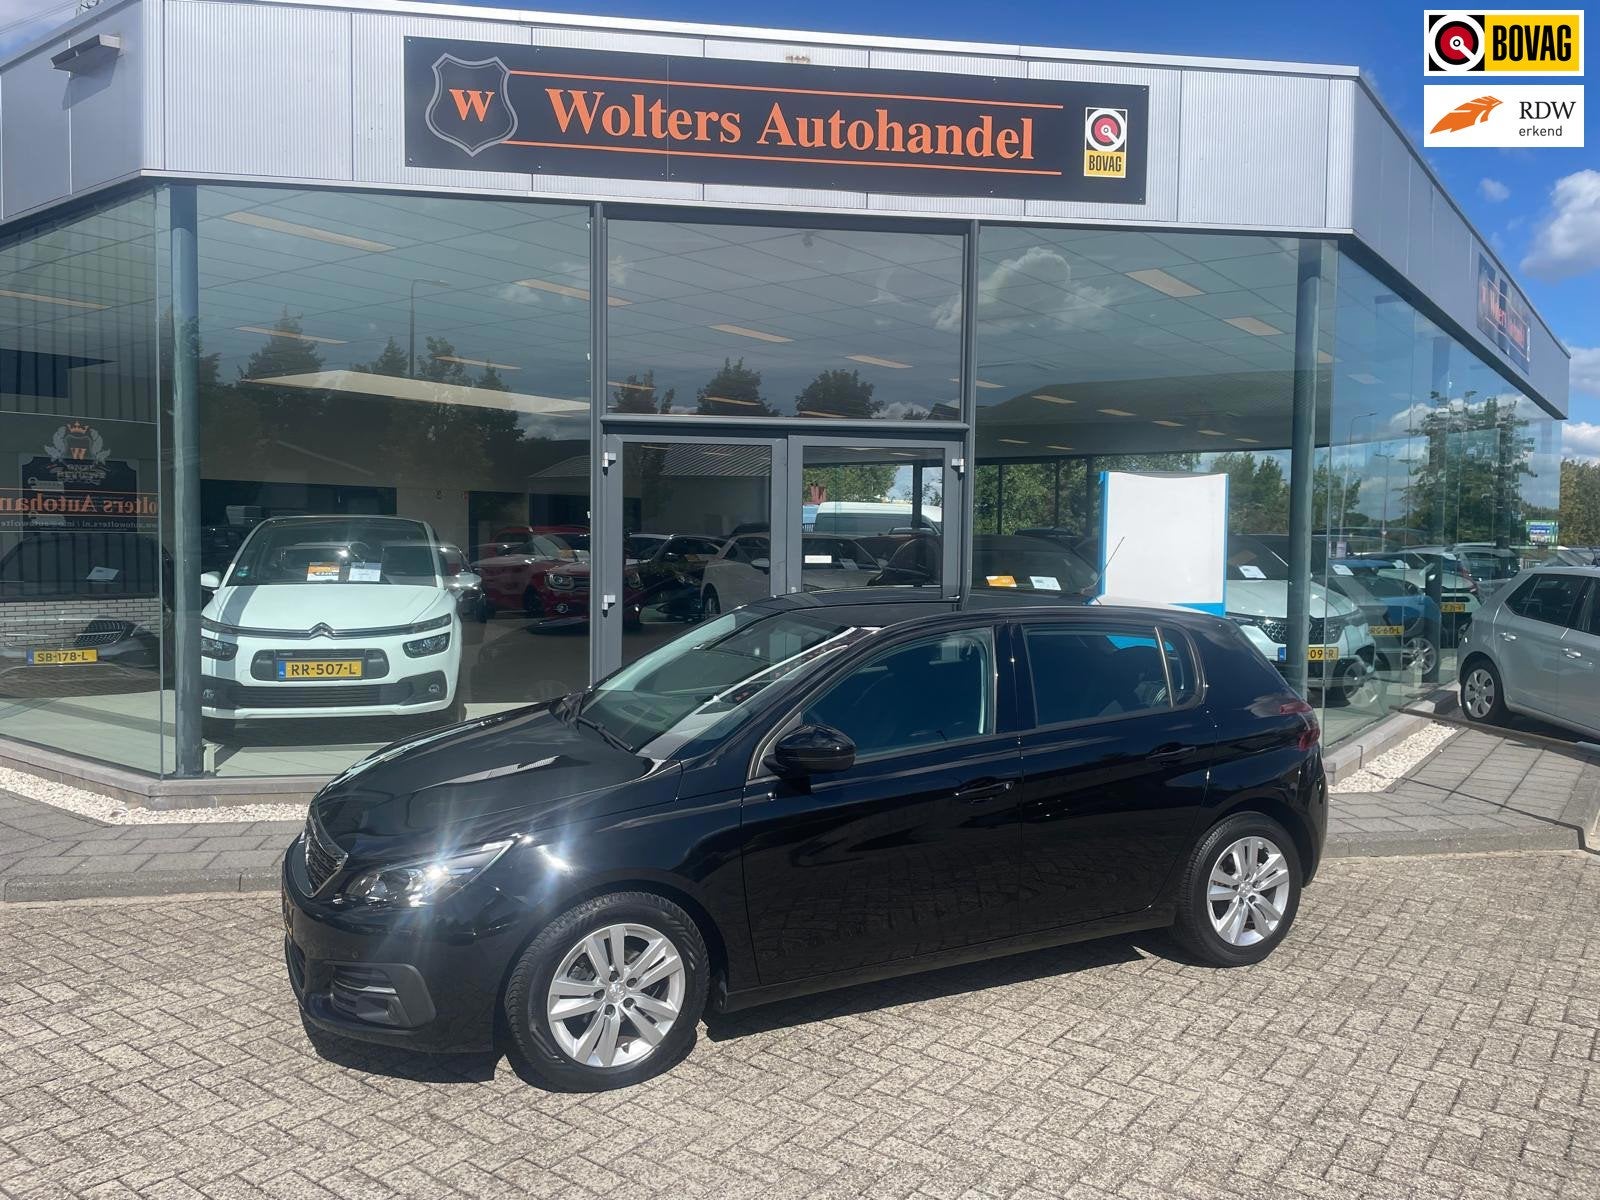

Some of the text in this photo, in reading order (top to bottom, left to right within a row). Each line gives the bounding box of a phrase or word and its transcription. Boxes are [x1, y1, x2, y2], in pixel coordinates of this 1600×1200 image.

[449, 88, 495, 122] W
[545, 88, 1035, 160] Wolters Autohandel
[1088, 153, 1122, 173] BOVAG
[37, 651, 88, 662] SB-178-L
[291, 663, 356, 676] RR-507-L
